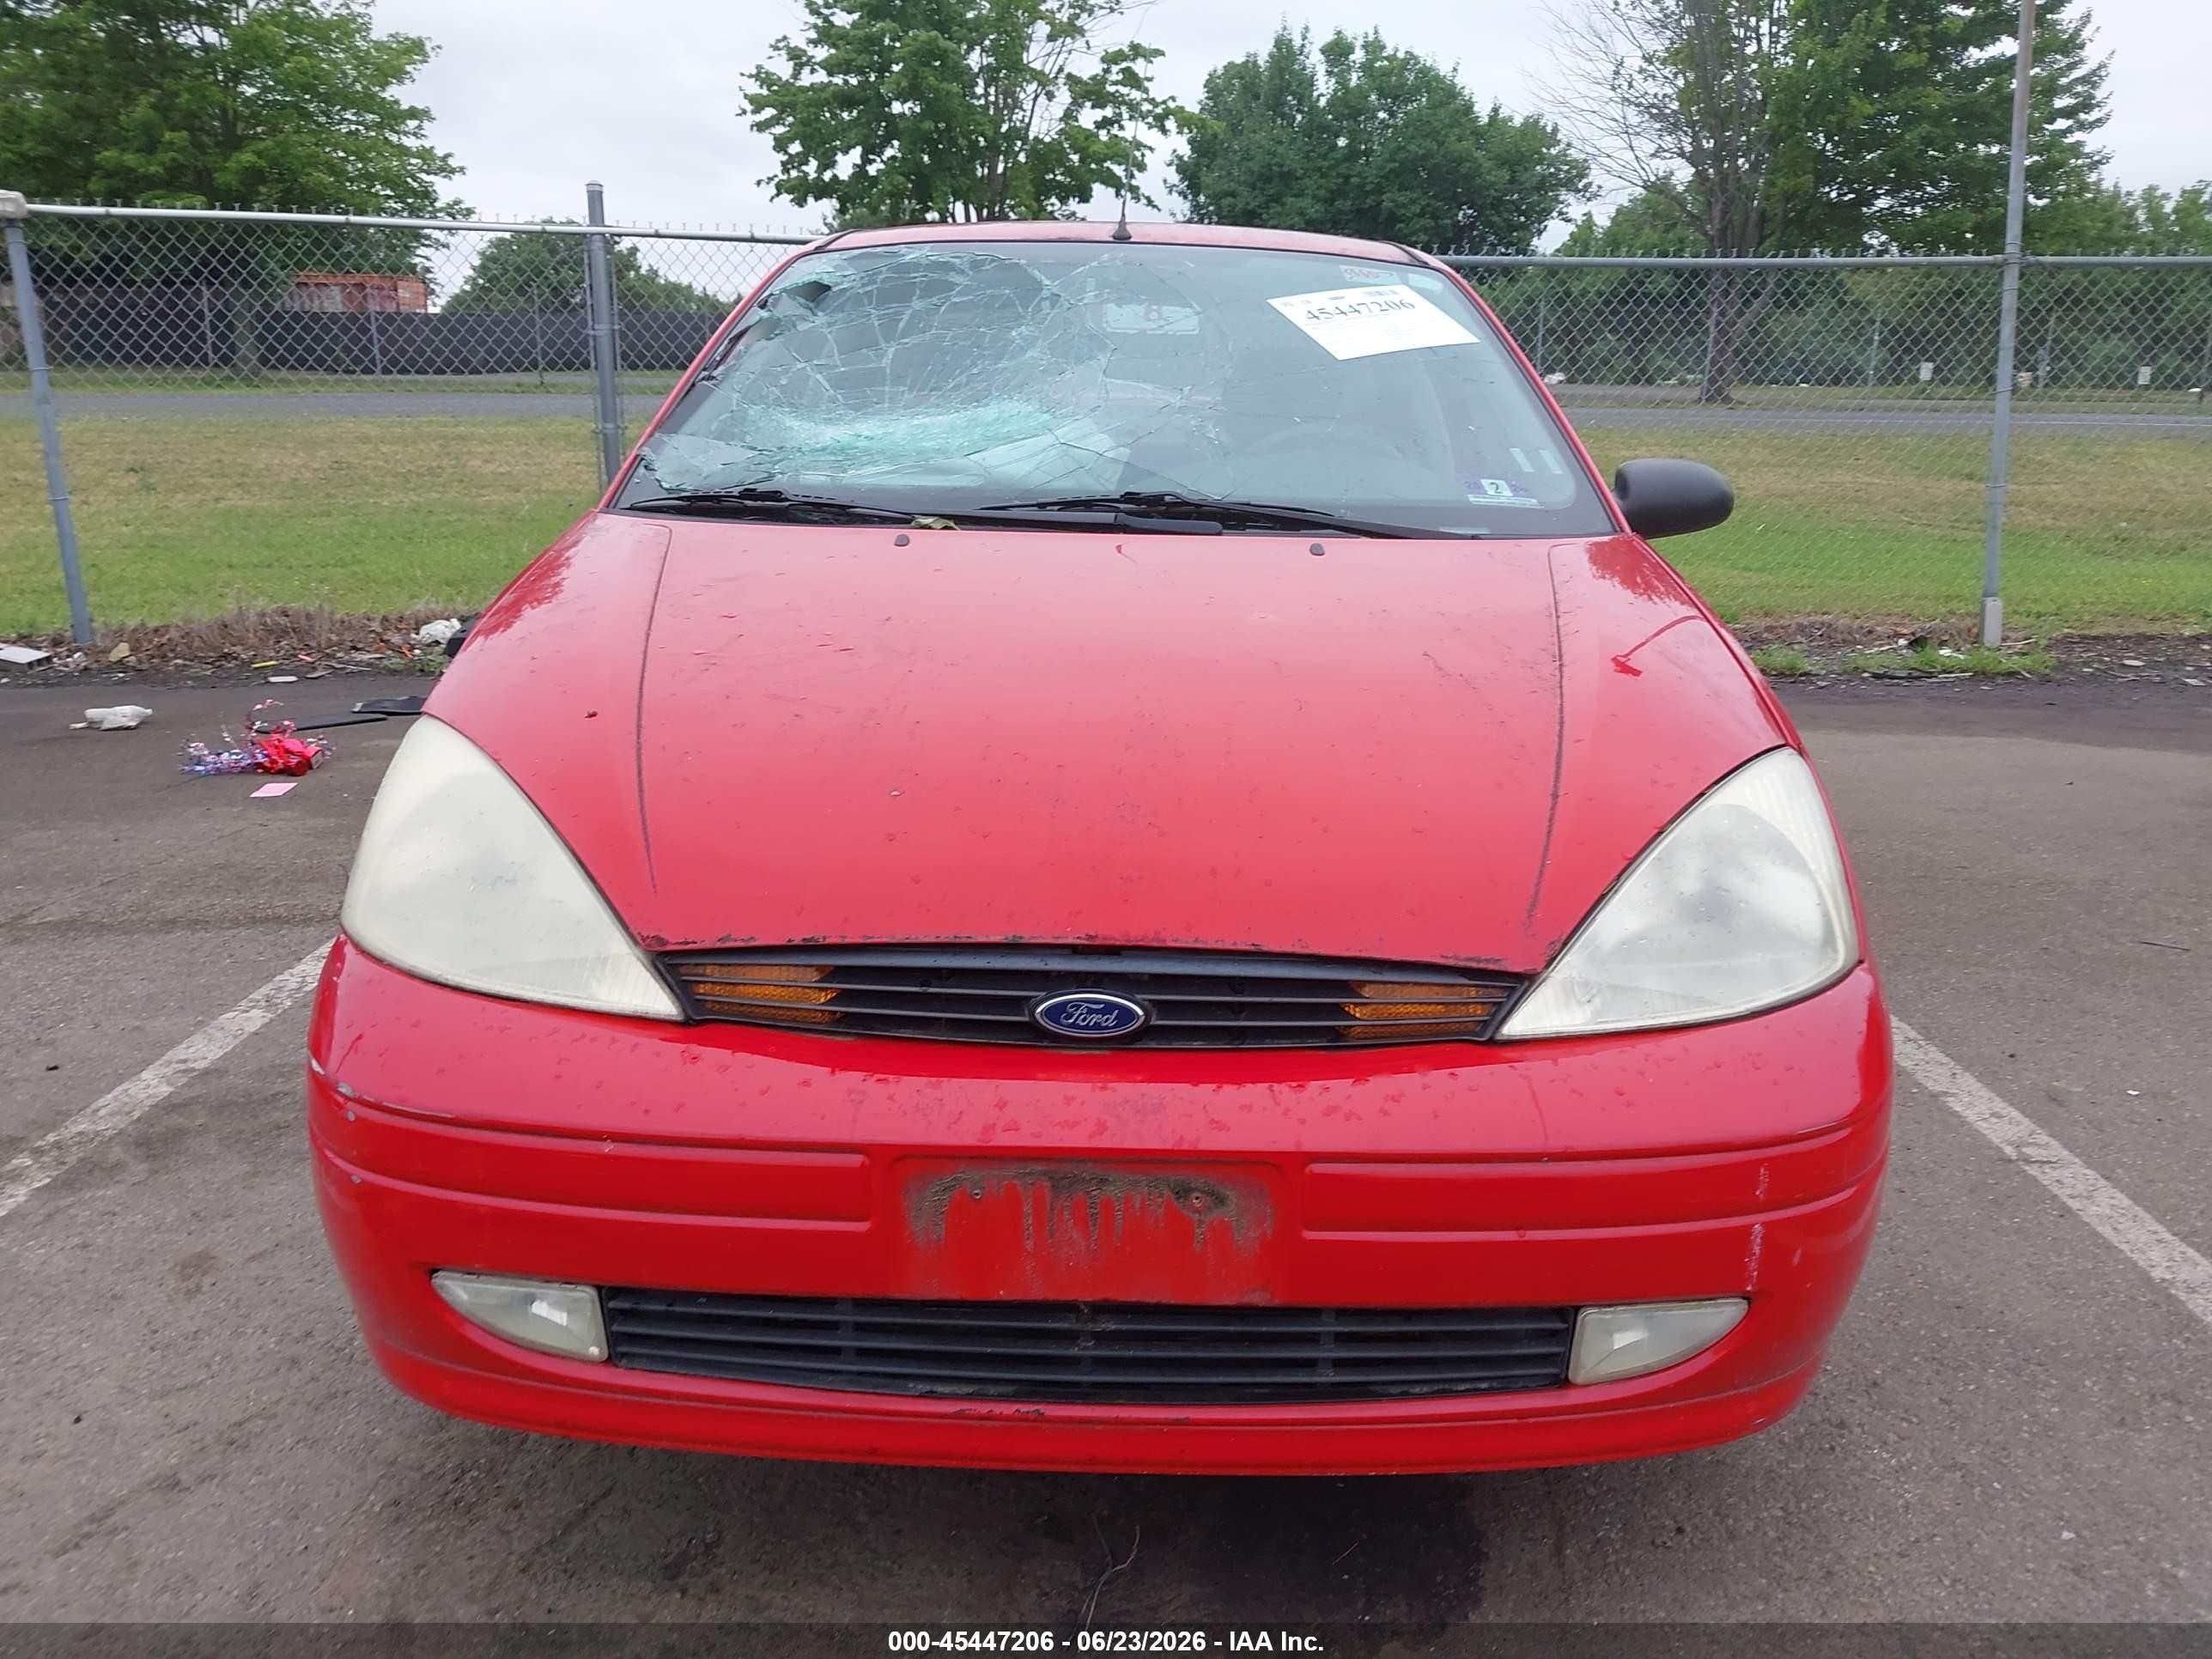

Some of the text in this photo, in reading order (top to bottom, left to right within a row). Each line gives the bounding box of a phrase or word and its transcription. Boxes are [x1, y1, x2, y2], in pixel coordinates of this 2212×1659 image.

[1306, 299, 1416, 321] 45447206
[1490, 482, 1503, 494] 2
[1060, 1001, 1119, 1027] Ford
